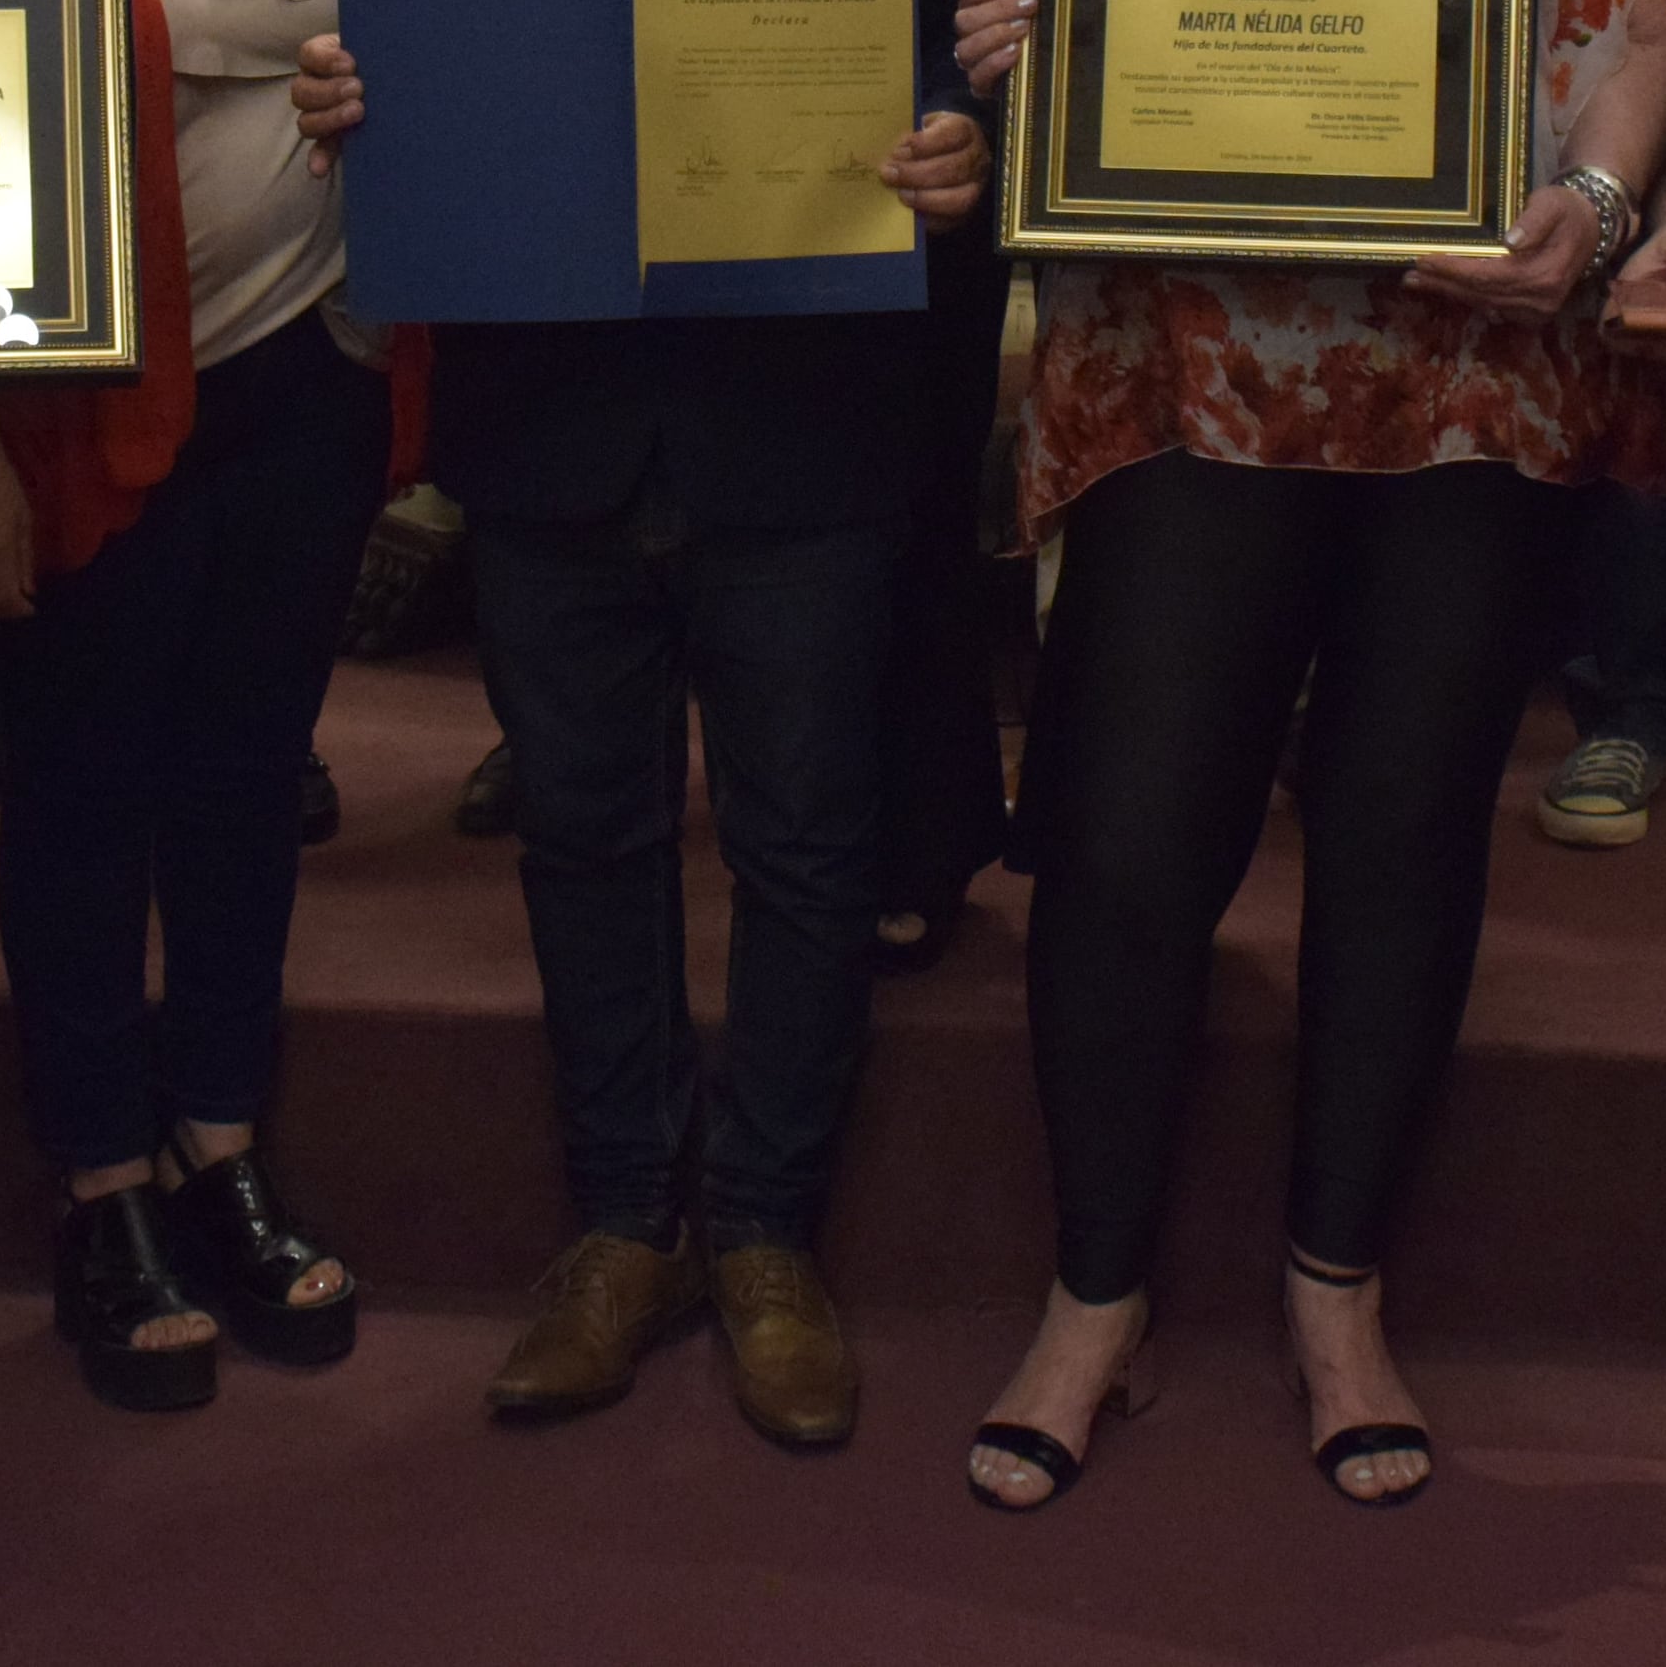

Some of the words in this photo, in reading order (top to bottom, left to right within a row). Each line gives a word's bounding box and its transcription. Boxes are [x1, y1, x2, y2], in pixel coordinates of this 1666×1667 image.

[1178, 11, 1236, 32] MARTA
[1243, 8, 1303, 34] NÉLIDA
[1310, 14, 1364, 35] GELFO
[1173, 39, 1196, 52] Hija
[1198, 39, 1211, 49] de
[1214, 39, 1229, 50] los
[1231, 40, 1294, 53] fundadores
[1297, 42, 1314, 53] del
